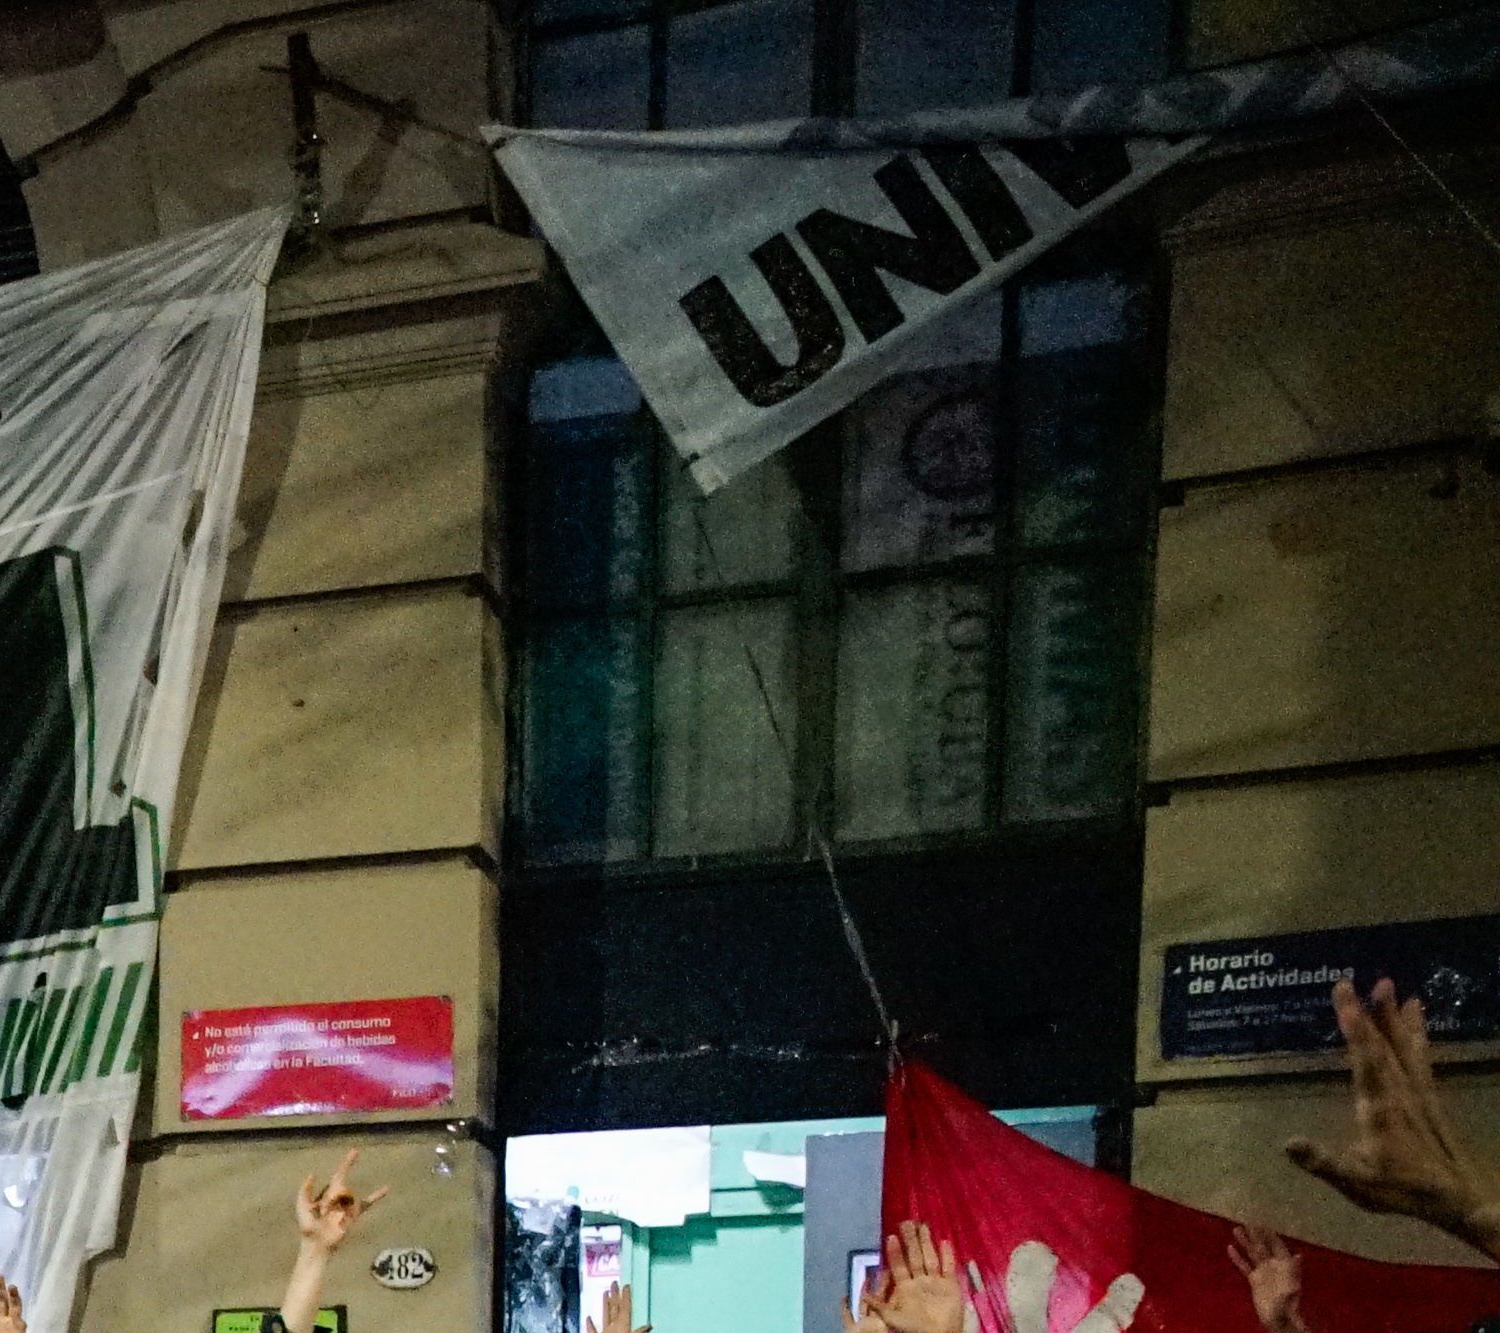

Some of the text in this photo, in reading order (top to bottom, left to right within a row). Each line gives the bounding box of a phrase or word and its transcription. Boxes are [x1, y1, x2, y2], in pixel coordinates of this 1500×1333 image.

[1188, 950, 1275, 973] Horario
[1187, 965, 1355, 995] de Actividades
[205, 1026, 222, 1038] No
[318, 1018, 329, 1031] el
[331, 1017, 391, 1030] consumo
[204, 1044, 225, 1058] y/o
[330, 1035, 345, 1048] de
[347, 1033, 397, 1047] bebidas
